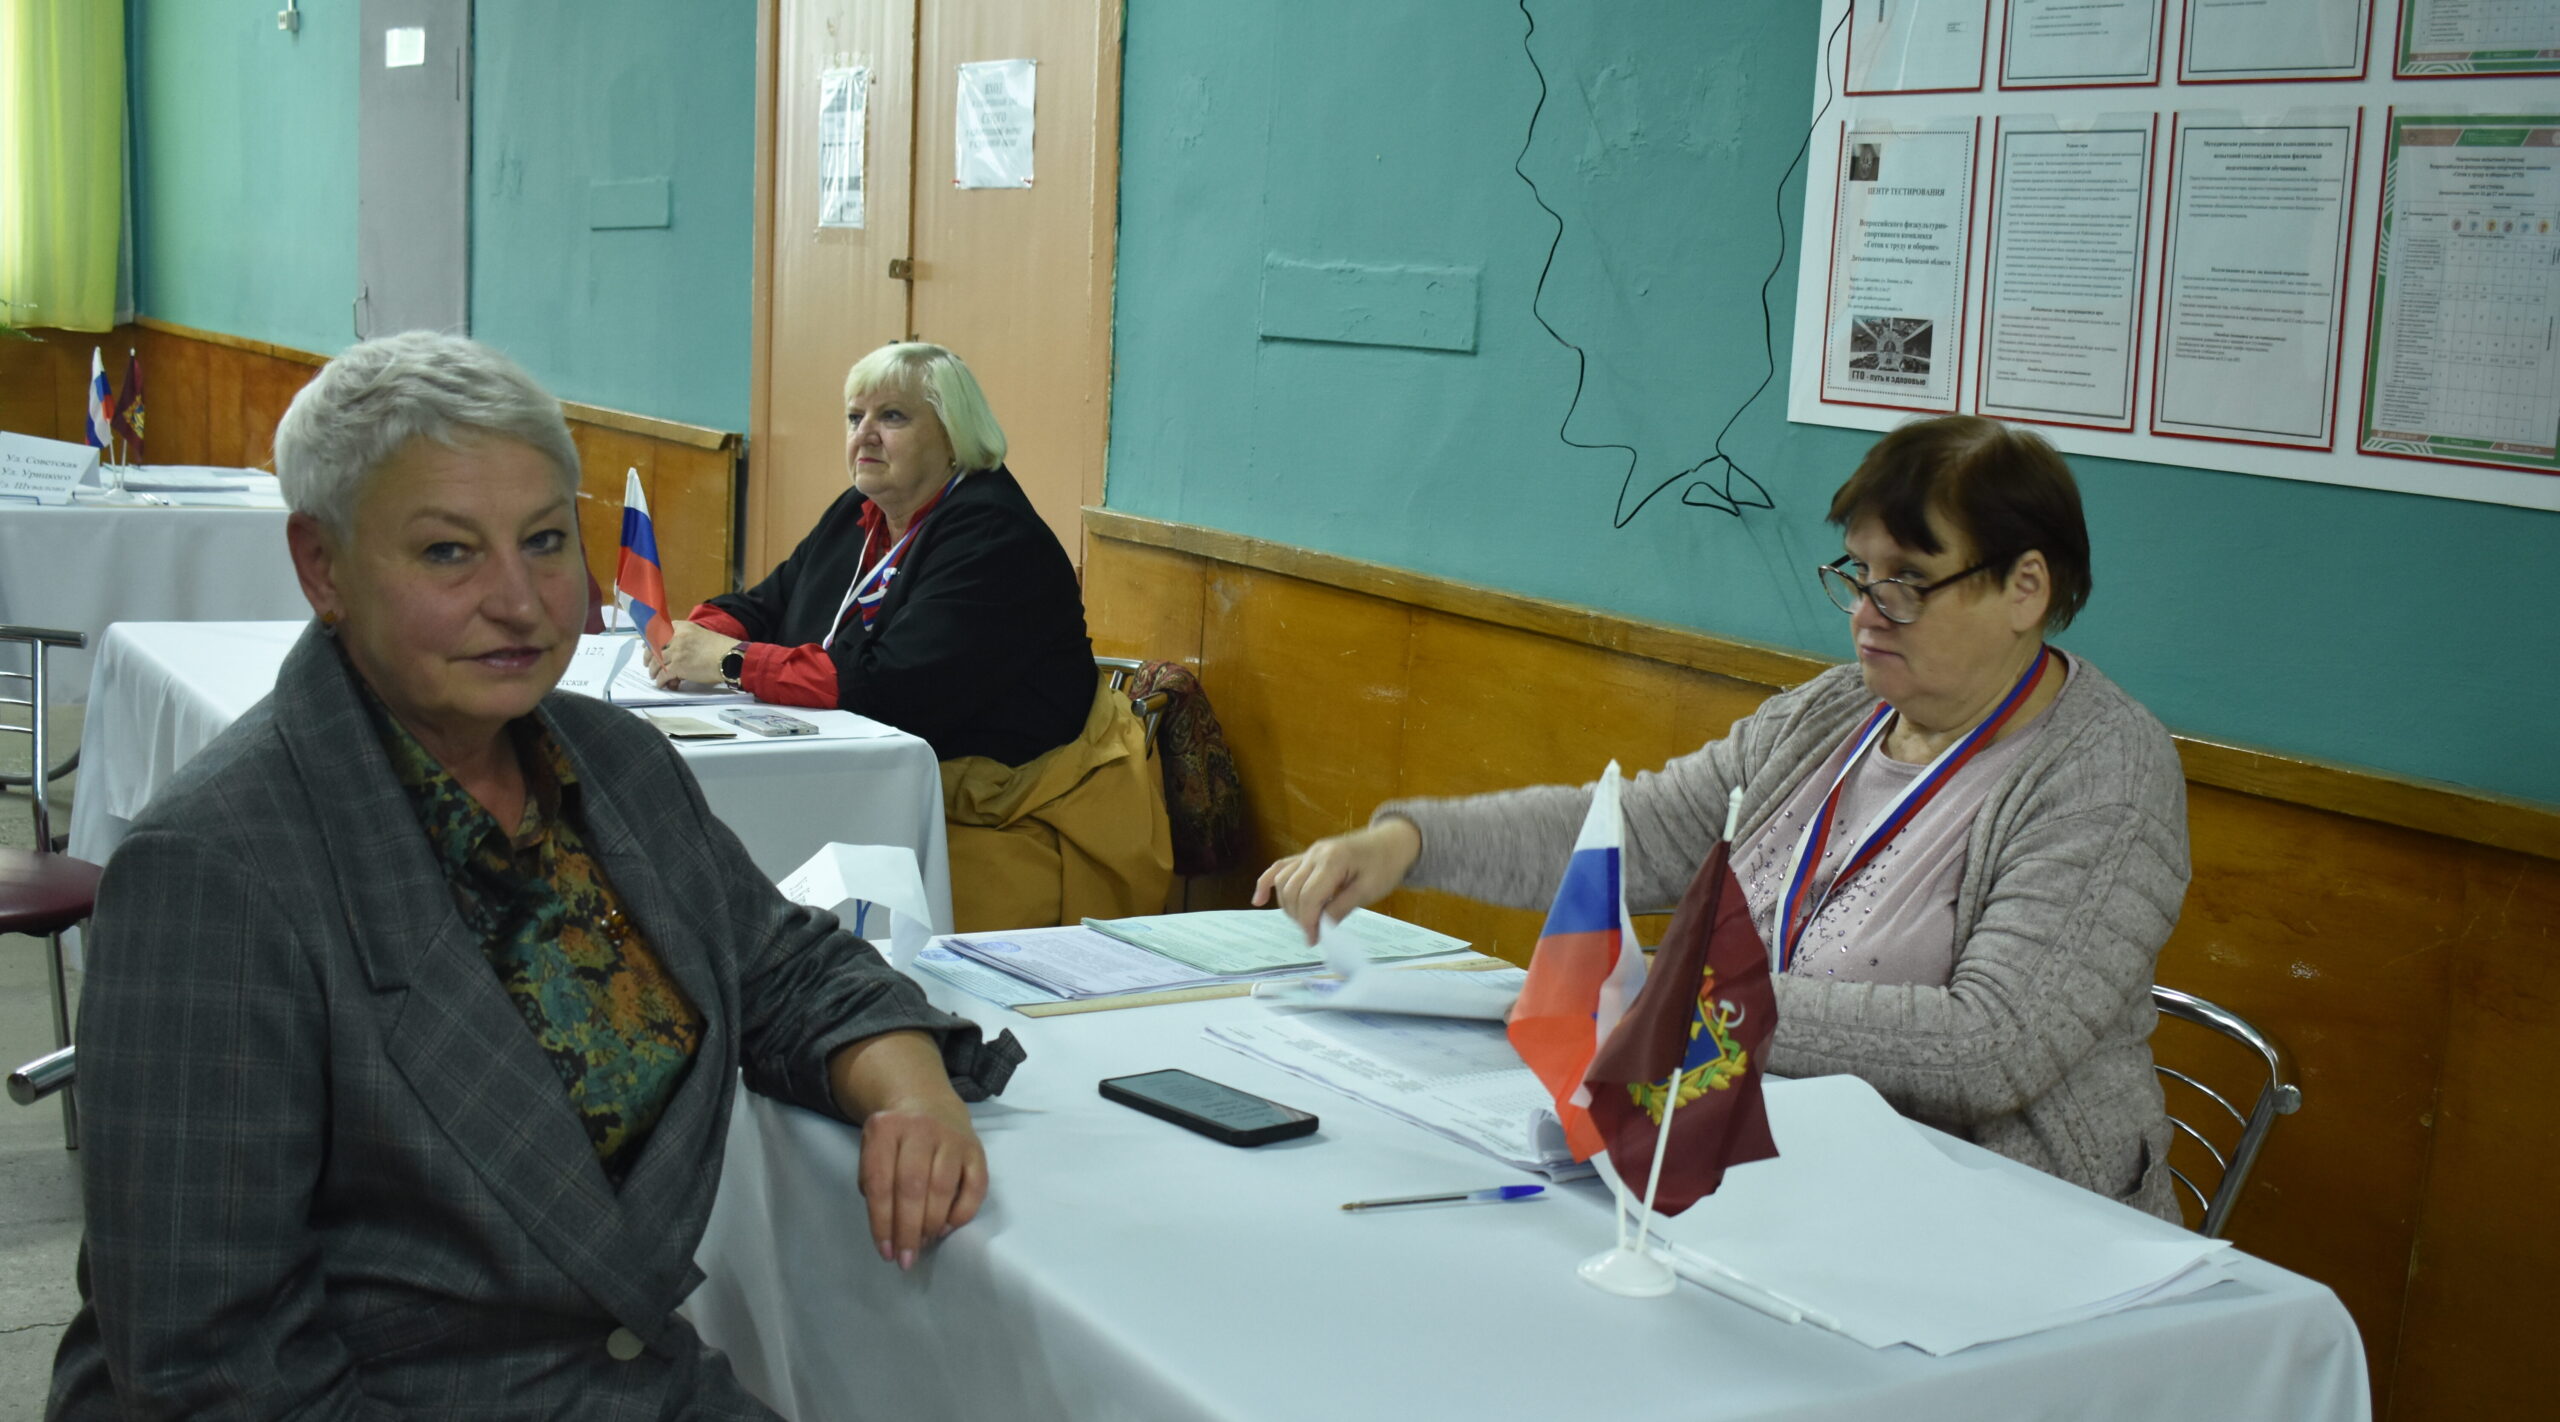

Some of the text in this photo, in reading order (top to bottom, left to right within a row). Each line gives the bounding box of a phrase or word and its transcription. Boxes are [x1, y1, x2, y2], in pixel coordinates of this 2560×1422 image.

[1867, 187, 1946, 197] ЦЕНТР ТЕСТИРОВАНИЯ
[1851, 370, 1865, 380] ГТО
[1869, 374, 1885, 383] путь
[1891, 375, 1927, 386] здоровью
[26, 456, 78, 469] Советская
